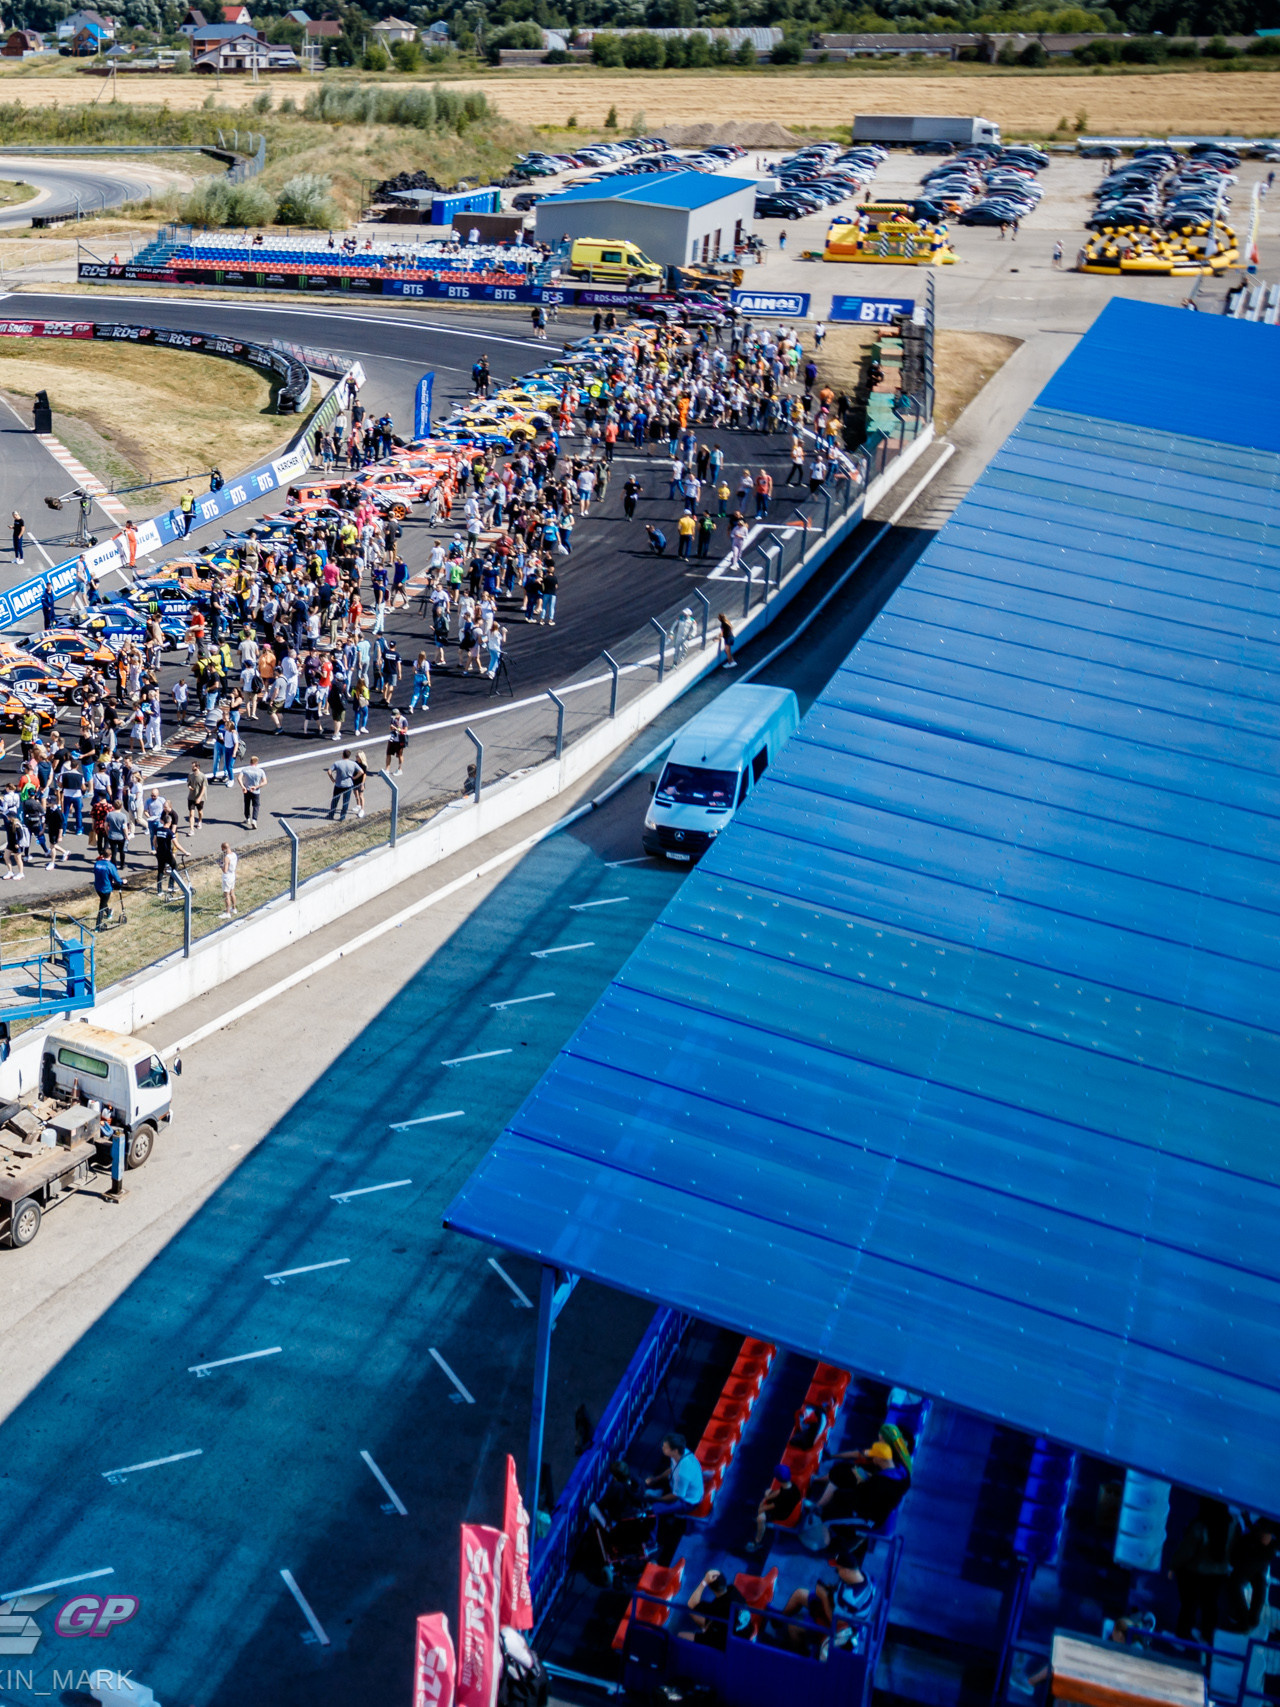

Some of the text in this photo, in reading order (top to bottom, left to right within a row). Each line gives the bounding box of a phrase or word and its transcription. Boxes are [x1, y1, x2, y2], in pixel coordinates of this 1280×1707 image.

[80, 265, 109, 277] RDS
[403, 284, 424, 295] ВТБ
[448, 286, 470, 298] ВТБ
[494, 288, 517, 300] ВТБ
[740, 297, 799, 310] AIMOL
[8, 323, 34, 333] Series
[43, 323, 75, 335] RDS
[112, 327, 139, 339] RDS
[168, 333, 192, 346] RDS
[256, 472, 274, 492] ВТБ
[230, 485, 247, 506] ВТБ
[200, 499, 220, 520] ВТБ
[93, 548, 120, 567] SAILUN
[464, 1542, 489, 1633] RDS
